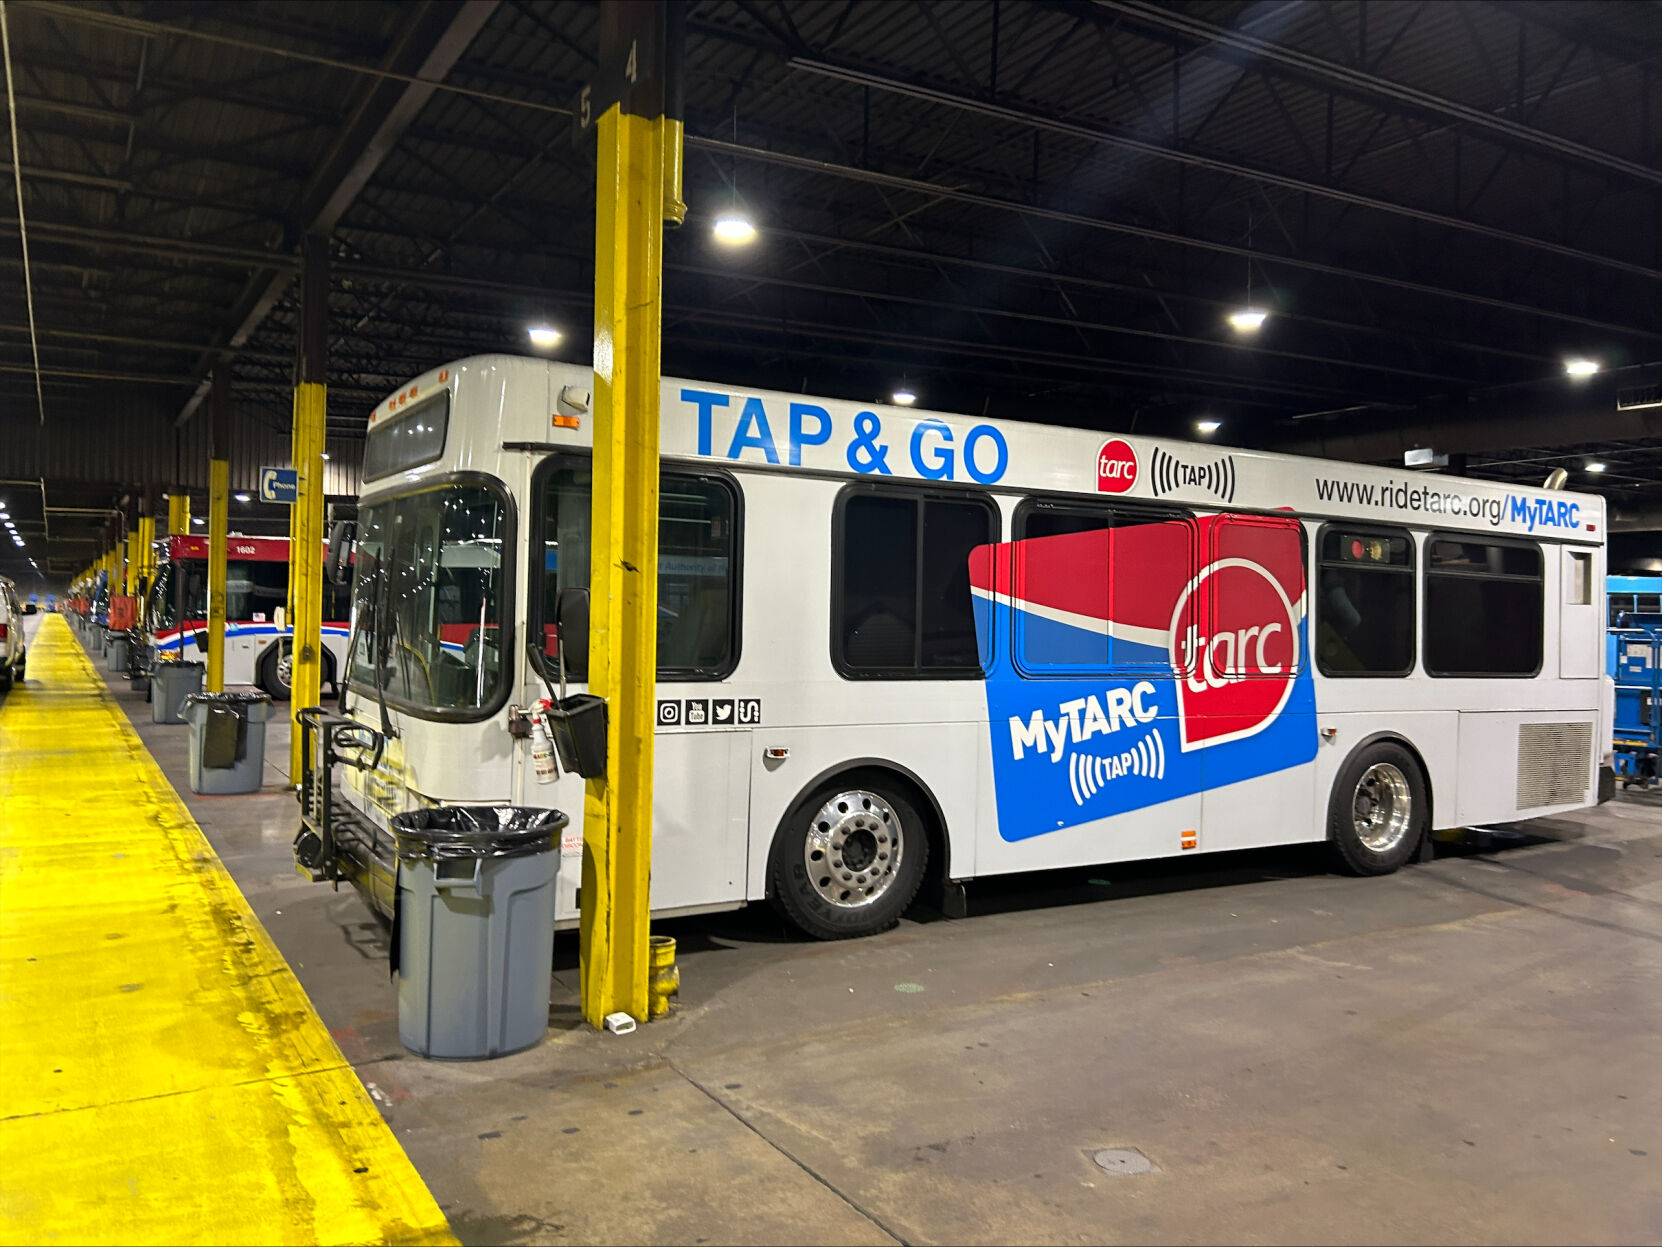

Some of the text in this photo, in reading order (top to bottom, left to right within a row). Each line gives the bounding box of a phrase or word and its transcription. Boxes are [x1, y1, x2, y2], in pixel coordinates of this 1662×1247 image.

[625, 38, 637, 84] 4
[580, 84, 591, 129] 5
[681, 388, 1009, 485] TAP & GO
[272, 480, 296, 490] Phone
[1100, 454, 1134, 479] tarc
[1181, 464, 1206, 486] TAP
[1315, 478, 1580, 532] www.ridetarc.org/MyTARC
[236, 545, 256, 555] 1602
[1181, 622, 1282, 693] tarc
[1009, 681, 1159, 763] MyTARC
[1102, 751, 1132, 780] TAP
